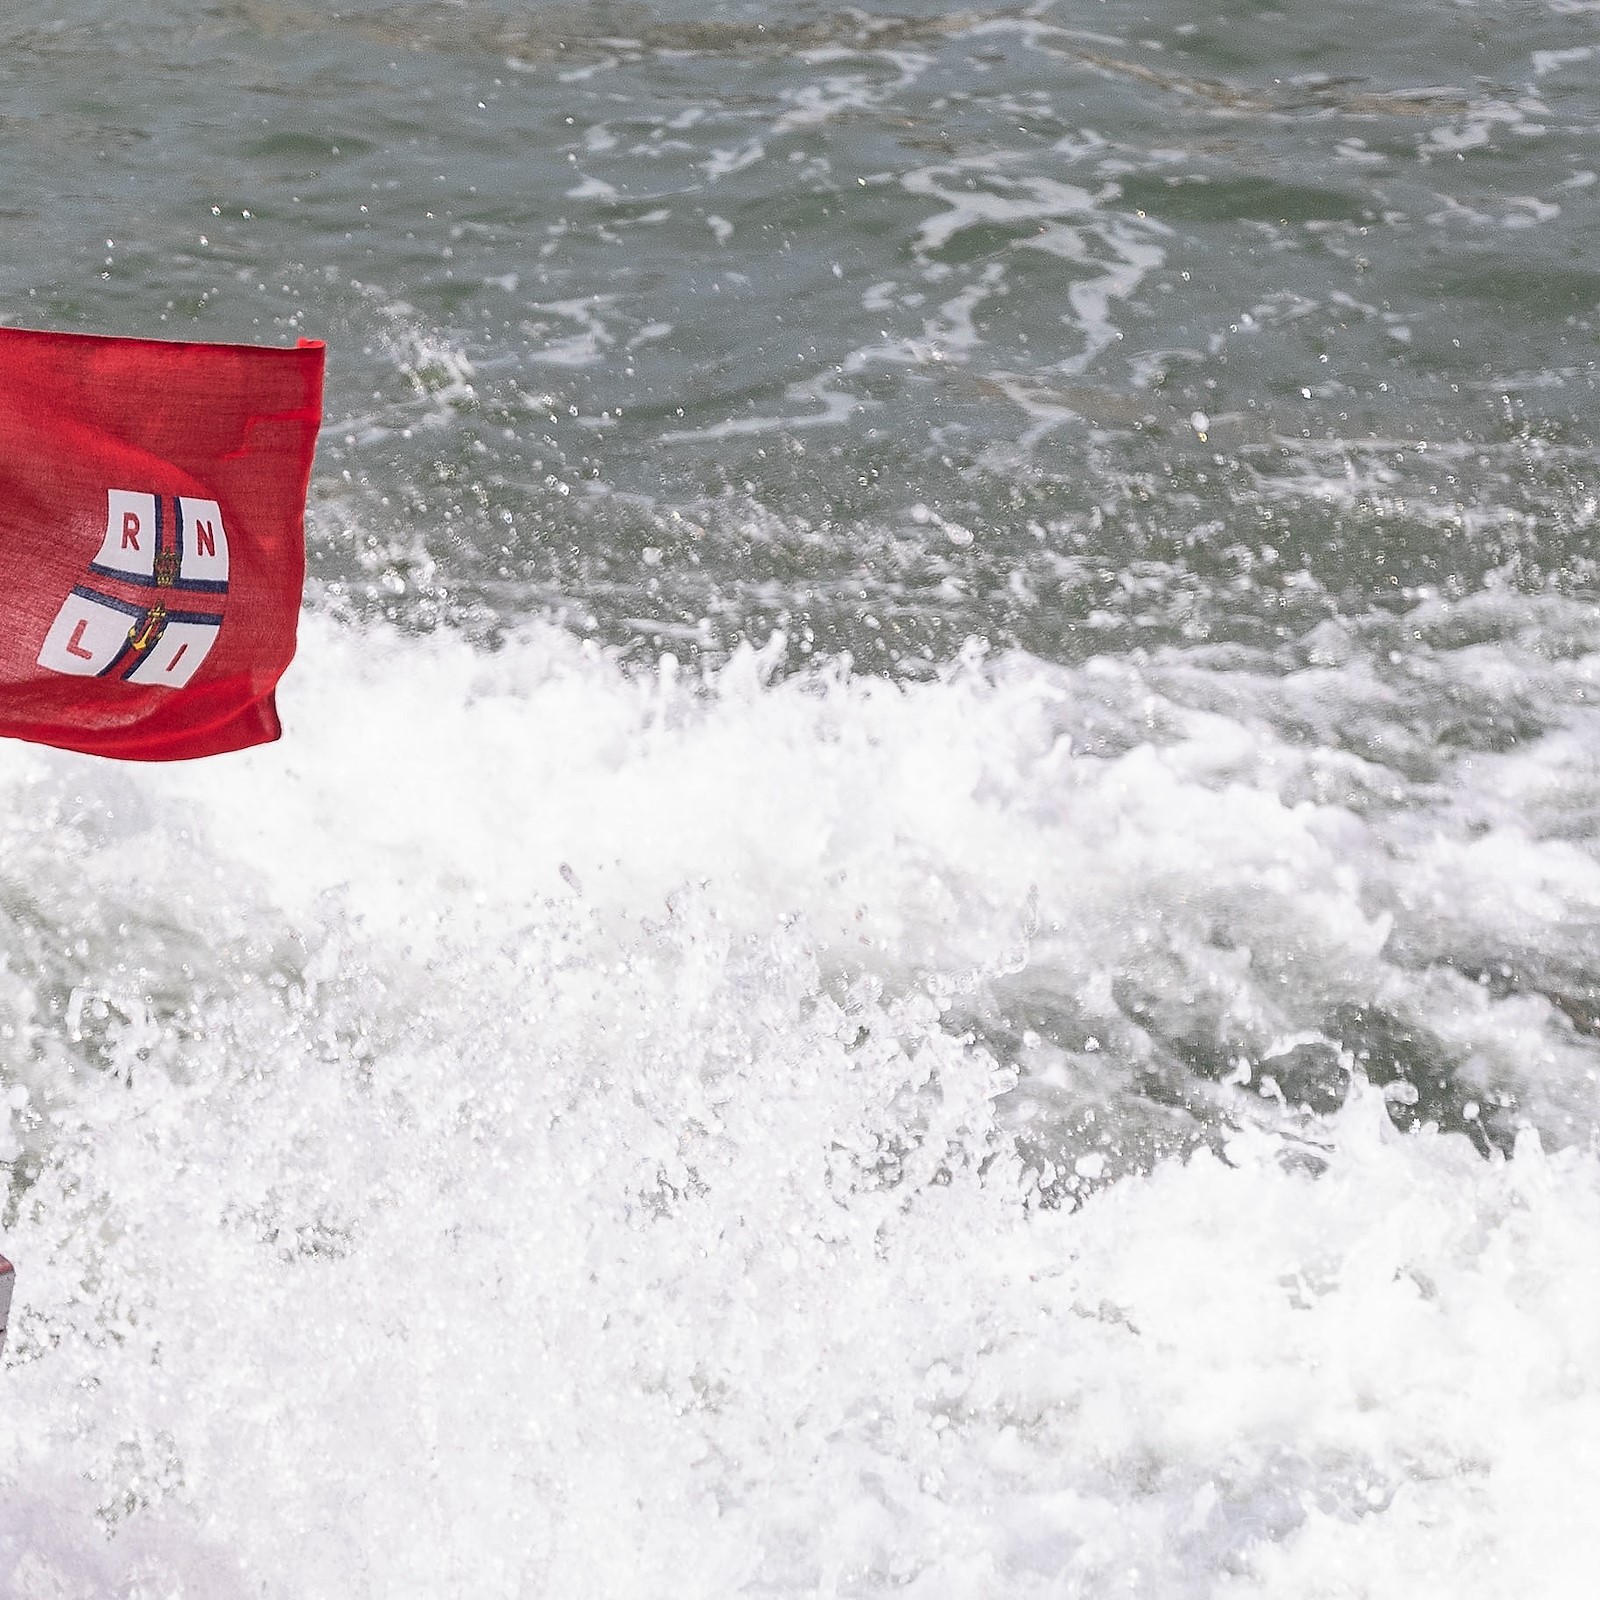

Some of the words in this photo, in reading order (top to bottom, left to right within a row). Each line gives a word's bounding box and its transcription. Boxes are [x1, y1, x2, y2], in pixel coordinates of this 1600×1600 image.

[121, 512, 140, 551] R
[195, 520, 216, 557] N
[65, 619, 93, 660] L
[165, 643, 189, 672] I
